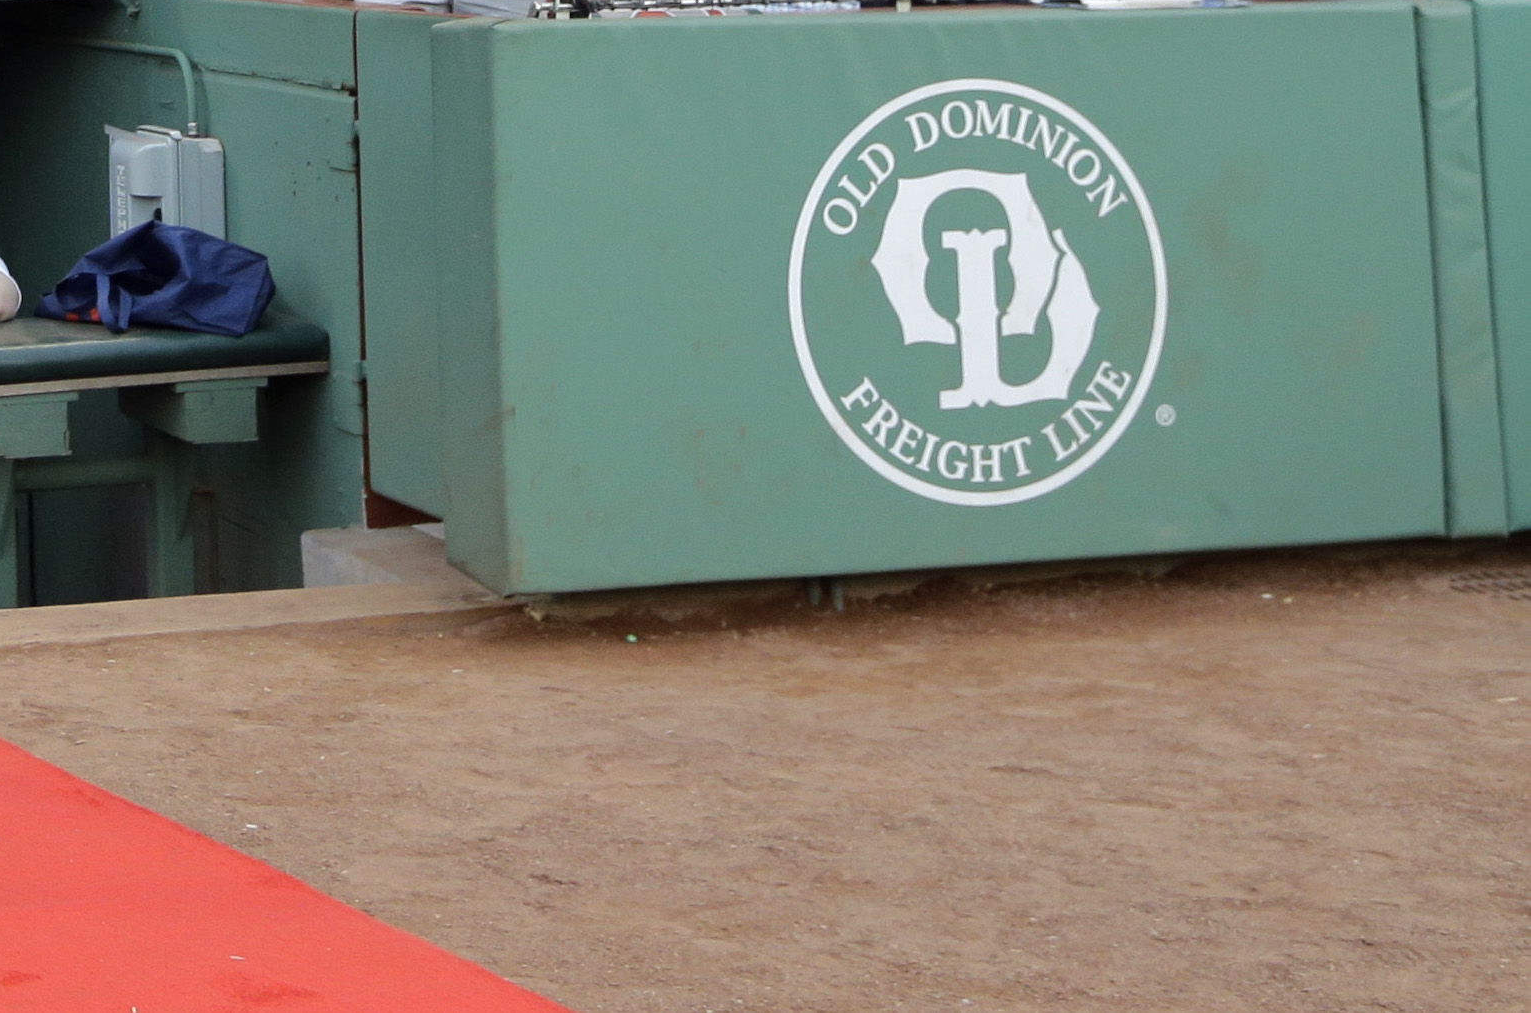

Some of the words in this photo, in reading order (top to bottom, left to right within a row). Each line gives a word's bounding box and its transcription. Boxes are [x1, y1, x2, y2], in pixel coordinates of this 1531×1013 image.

[116, 164, 127, 235] TELEPH
[822, 142, 896, 236] OLD
[905, 99, 1129, 218] DOMINION
[840, 377, 1032, 483] FREIGHT
[1041, 360, 1133, 462] LINE
